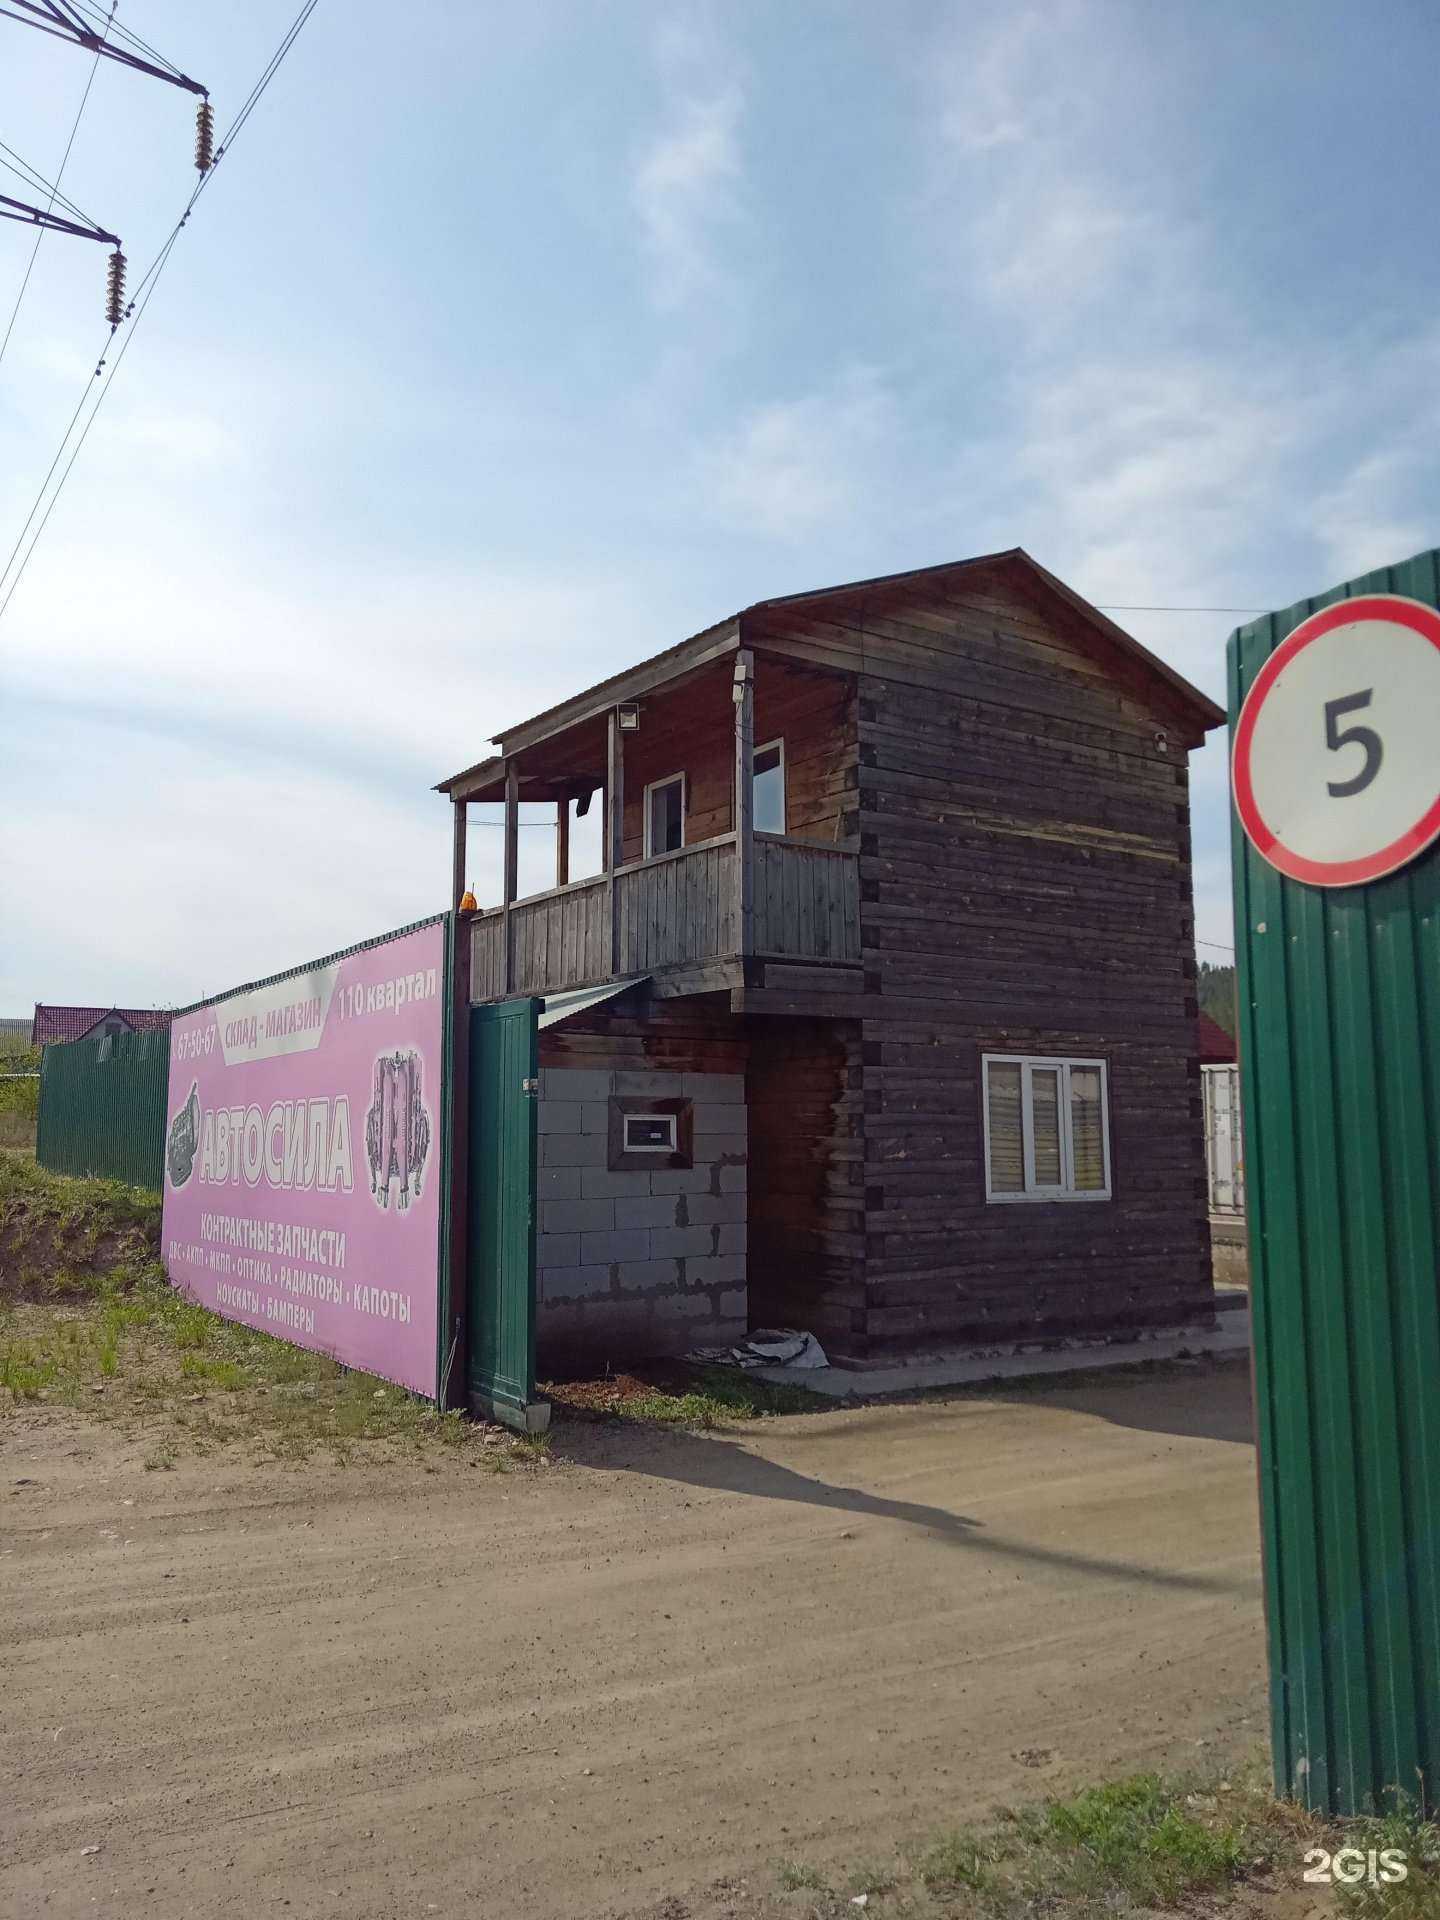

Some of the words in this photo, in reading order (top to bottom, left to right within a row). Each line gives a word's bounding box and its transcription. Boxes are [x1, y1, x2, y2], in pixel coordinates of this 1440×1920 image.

[1324, 687, 1384, 798] 5
[338, 982, 364, 1021] 110
[366, 968, 436, 1016] квартал
[177, 1023, 217, 1060] 67-50-67
[225, 1015, 258, 1050] СКЛАД
[265, 998, 322, 1039] МАГАЗИН
[200, 1094, 354, 1193] АВТОСИЛА
[200, 1213, 275, 1253] КОНТРАКТНЫЕ
[275, 1223, 346, 1268] ЗАПЧАСТИ
[237, 1256, 272, 1285] ОПТИКА
[280, 1266, 343, 1305] РАДИАТОРЫ
[353, 1283, 411, 1323] КАПОТЫ
[267, 1296, 315, 1335] БАМПЕРЫ
